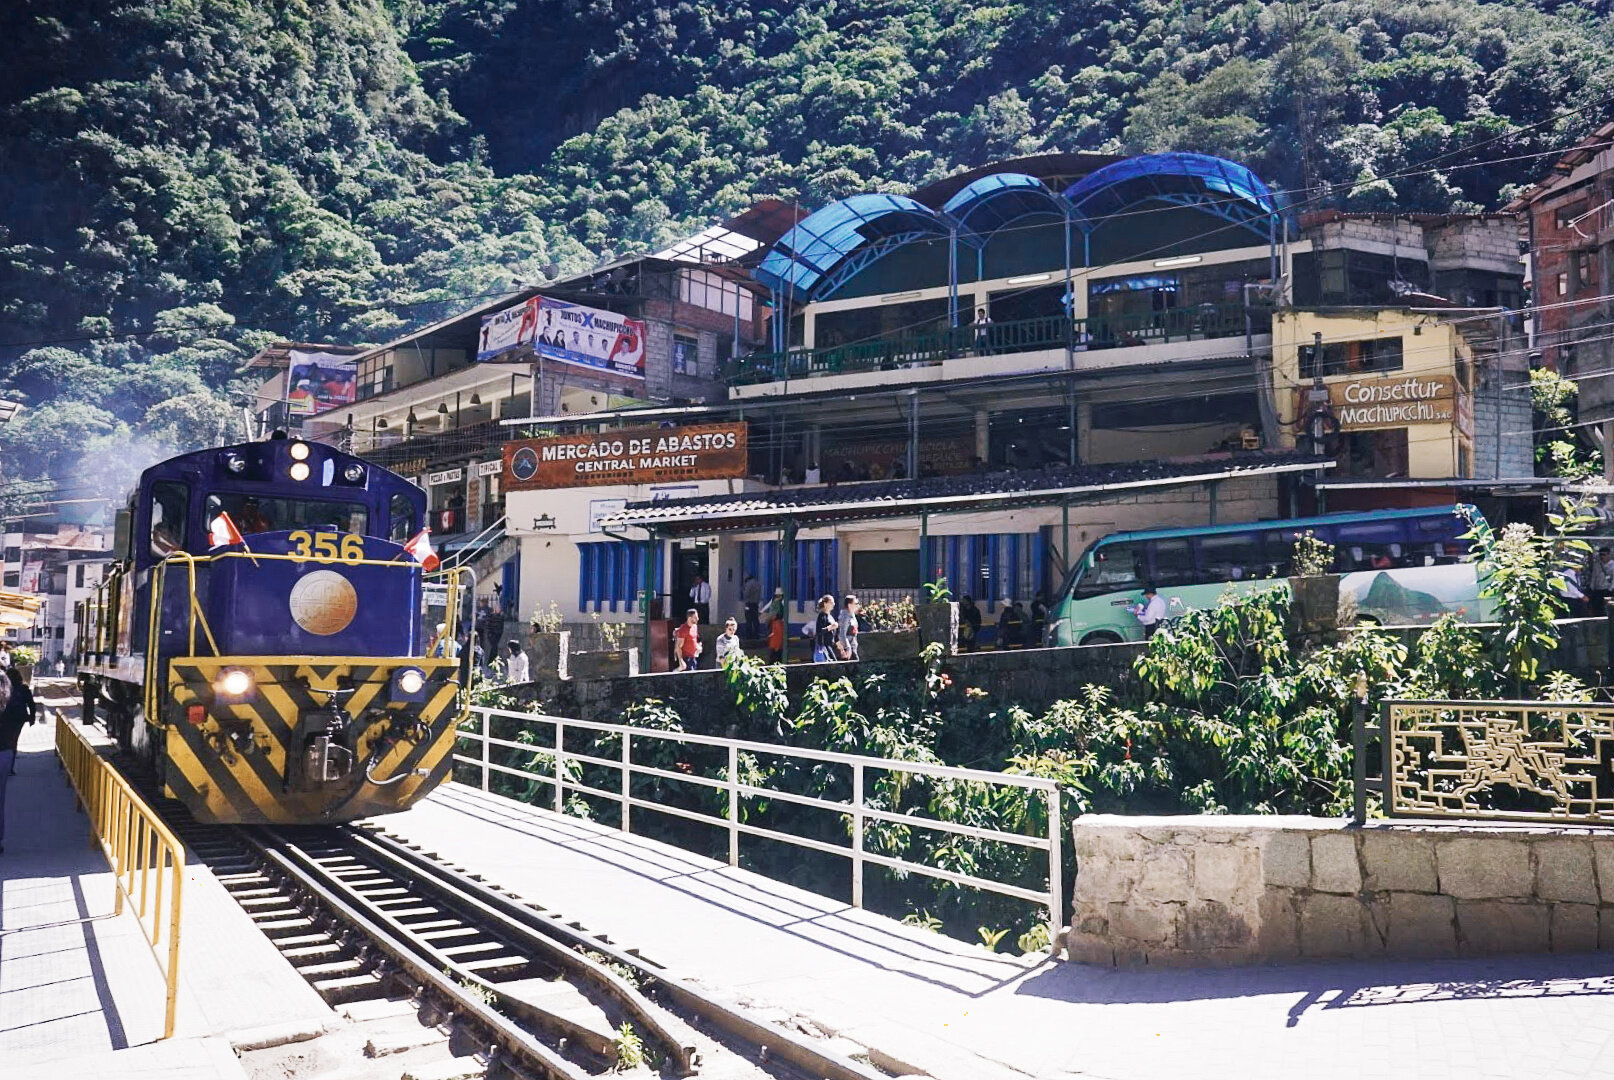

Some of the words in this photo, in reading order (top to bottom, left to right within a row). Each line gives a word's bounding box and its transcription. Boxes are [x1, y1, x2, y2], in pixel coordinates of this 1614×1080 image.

[580, 310, 594, 329] X
[1345, 378, 1444, 403] Consettur
[541, 440, 624, 462] MERCADO
[628, 438, 652, 456] DE
[655, 432, 738, 454] ABASTOS
[575, 459, 636, 473] CENTRAL
[639, 454, 699, 469] MARKET
[287, 530, 365, 566] 356
